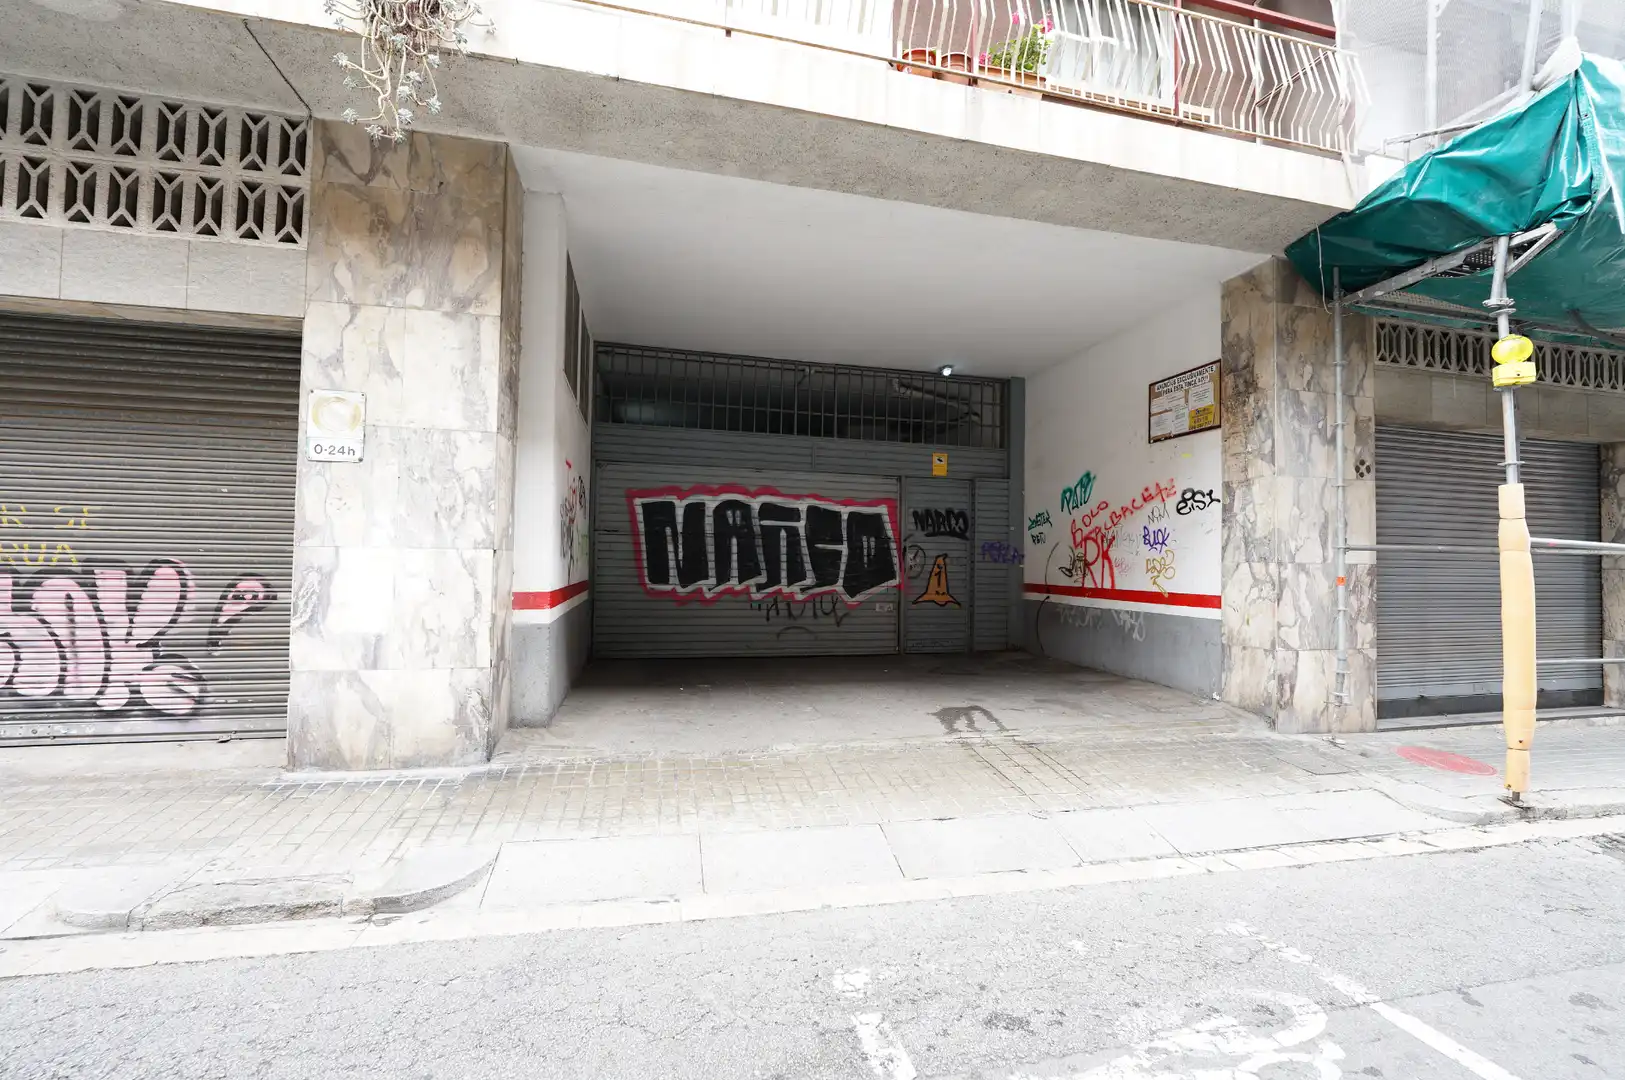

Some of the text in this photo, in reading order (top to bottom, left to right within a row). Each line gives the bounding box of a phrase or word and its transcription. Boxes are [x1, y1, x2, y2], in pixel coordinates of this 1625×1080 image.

[1177, 365, 1214, 384] EXCLUSIVAMENTE
[1162, 386, 1173, 396] PARA
[1173, 383, 1184, 393] ESTA
[1184, 379, 1197, 390] FINCA
